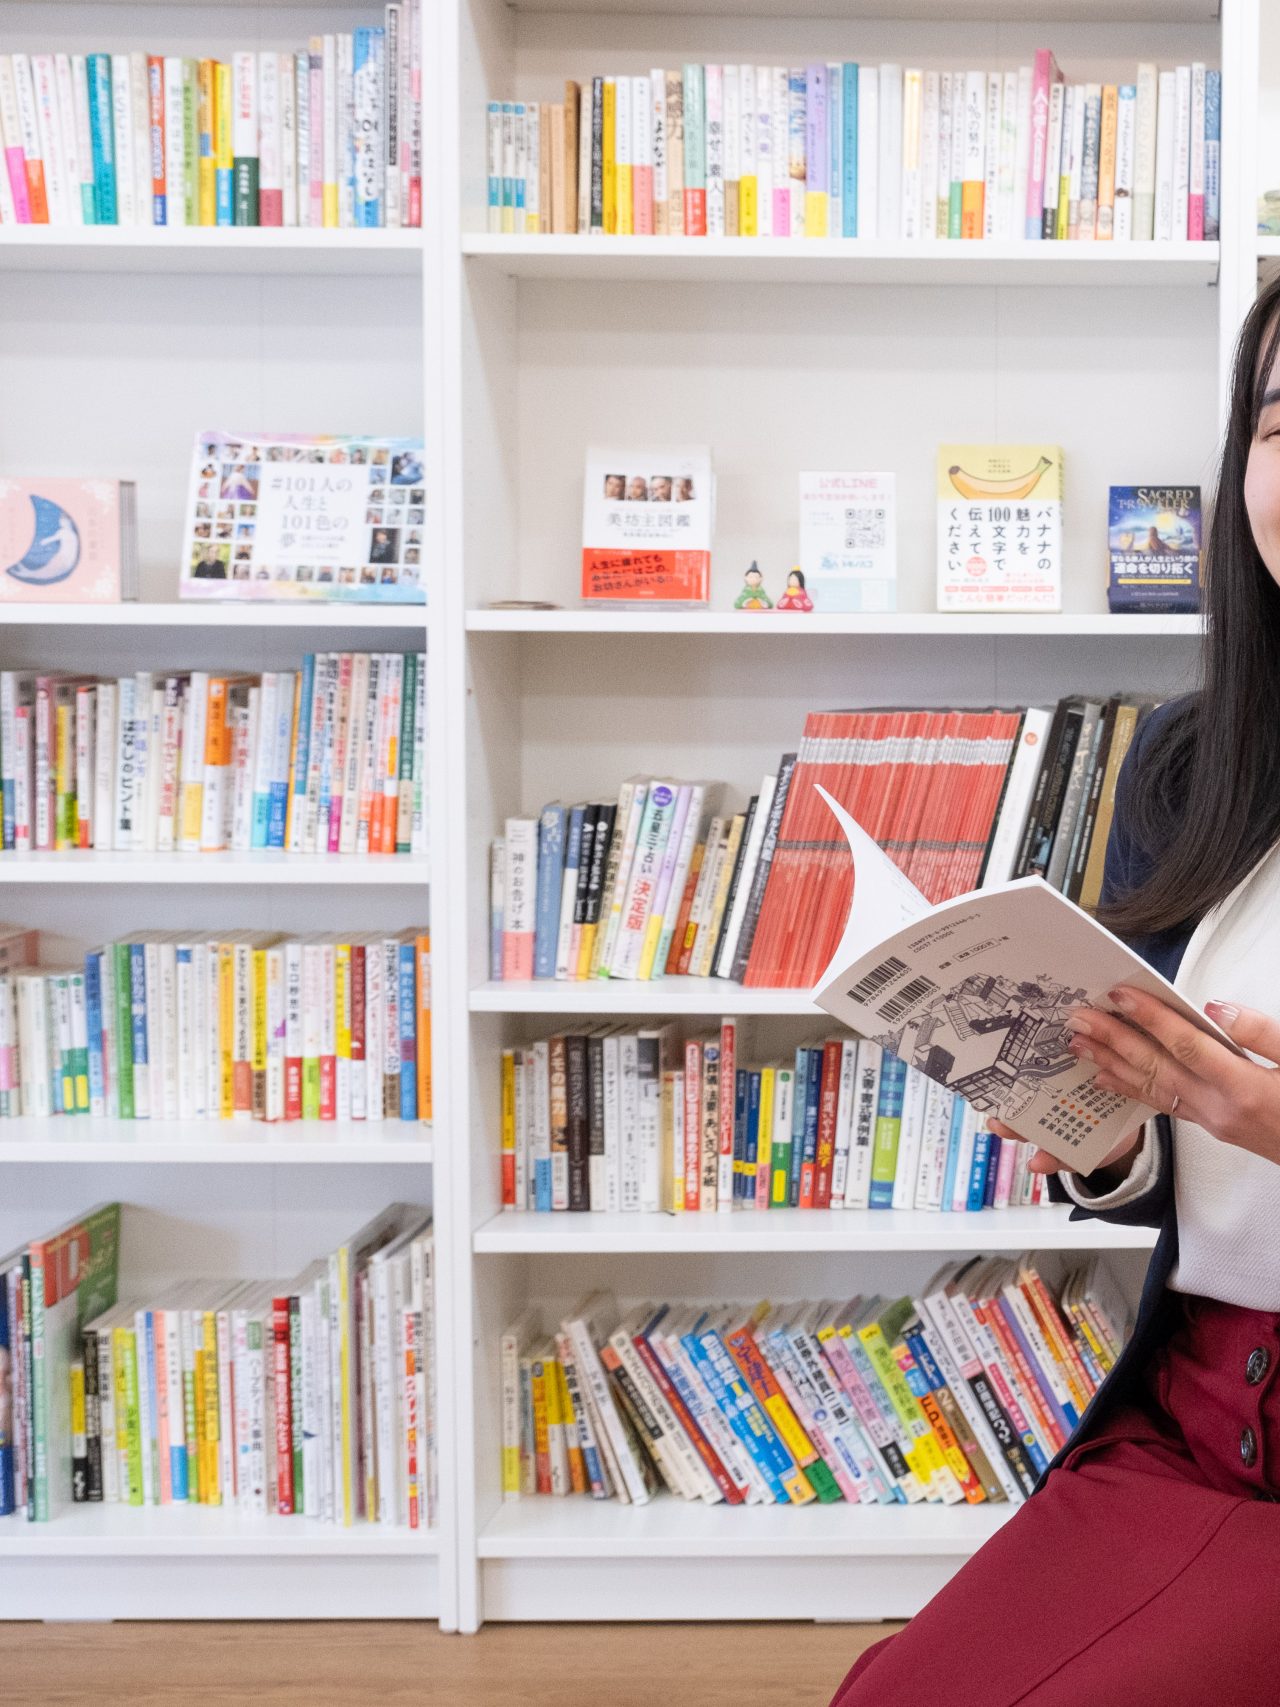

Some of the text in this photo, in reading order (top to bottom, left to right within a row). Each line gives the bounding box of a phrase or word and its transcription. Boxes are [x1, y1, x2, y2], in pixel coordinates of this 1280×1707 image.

[1137, 488, 1194, 502] SACRED
[947, 508, 963, 571] ください
[968, 507, 982, 554] 伝えて
[1016, 507, 1031, 555] 魅力を
[1036, 507, 1052, 571] バナナの
[1113, 563, 1194, 575] 運命を切り拓く
[1038, 1104, 1061, 1126] 第1章
[1047, 1110, 1069, 1131] 第2章
[1055, 1115, 1077, 1137] 第3章
[1063, 1121, 1085, 1141] 第4章
[1071, 1126, 1093, 1146] 第5章
